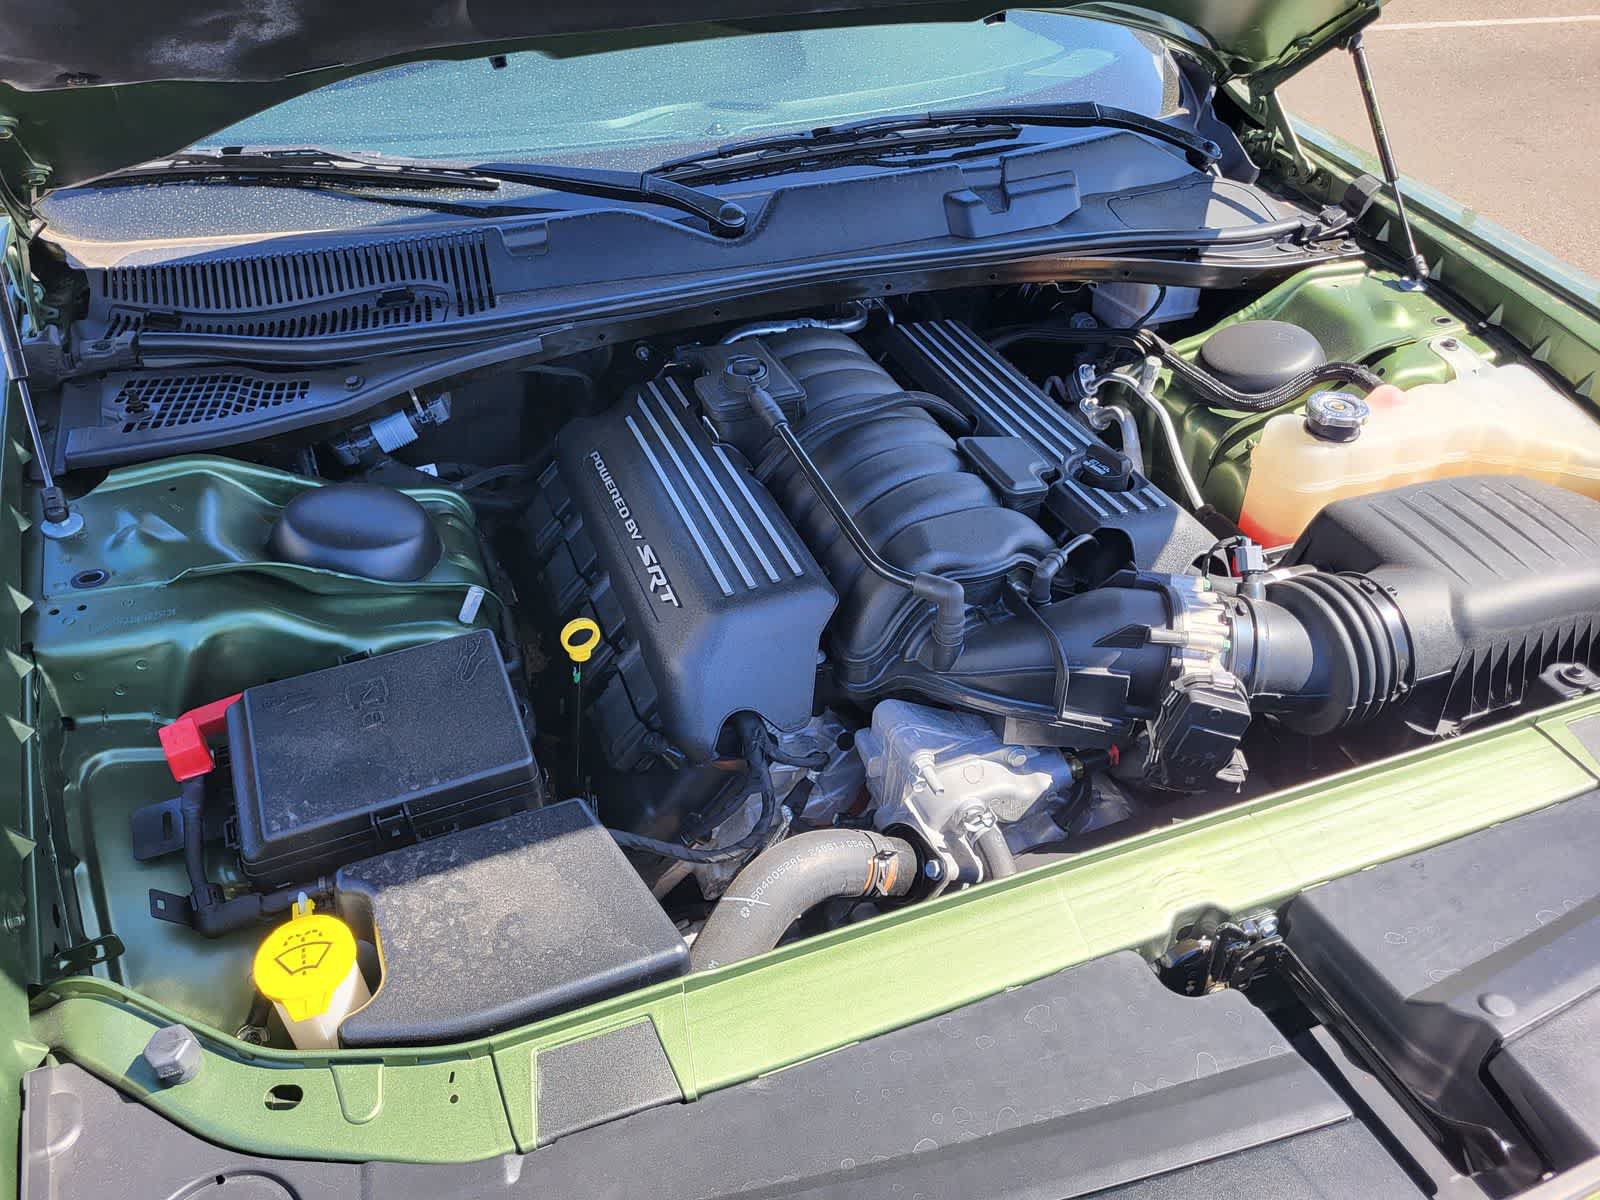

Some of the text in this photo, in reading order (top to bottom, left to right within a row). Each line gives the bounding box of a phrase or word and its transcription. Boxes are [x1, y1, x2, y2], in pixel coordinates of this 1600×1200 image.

[590, 451, 643, 539] POWERED BY
[636, 544, 679, 606] SRT
